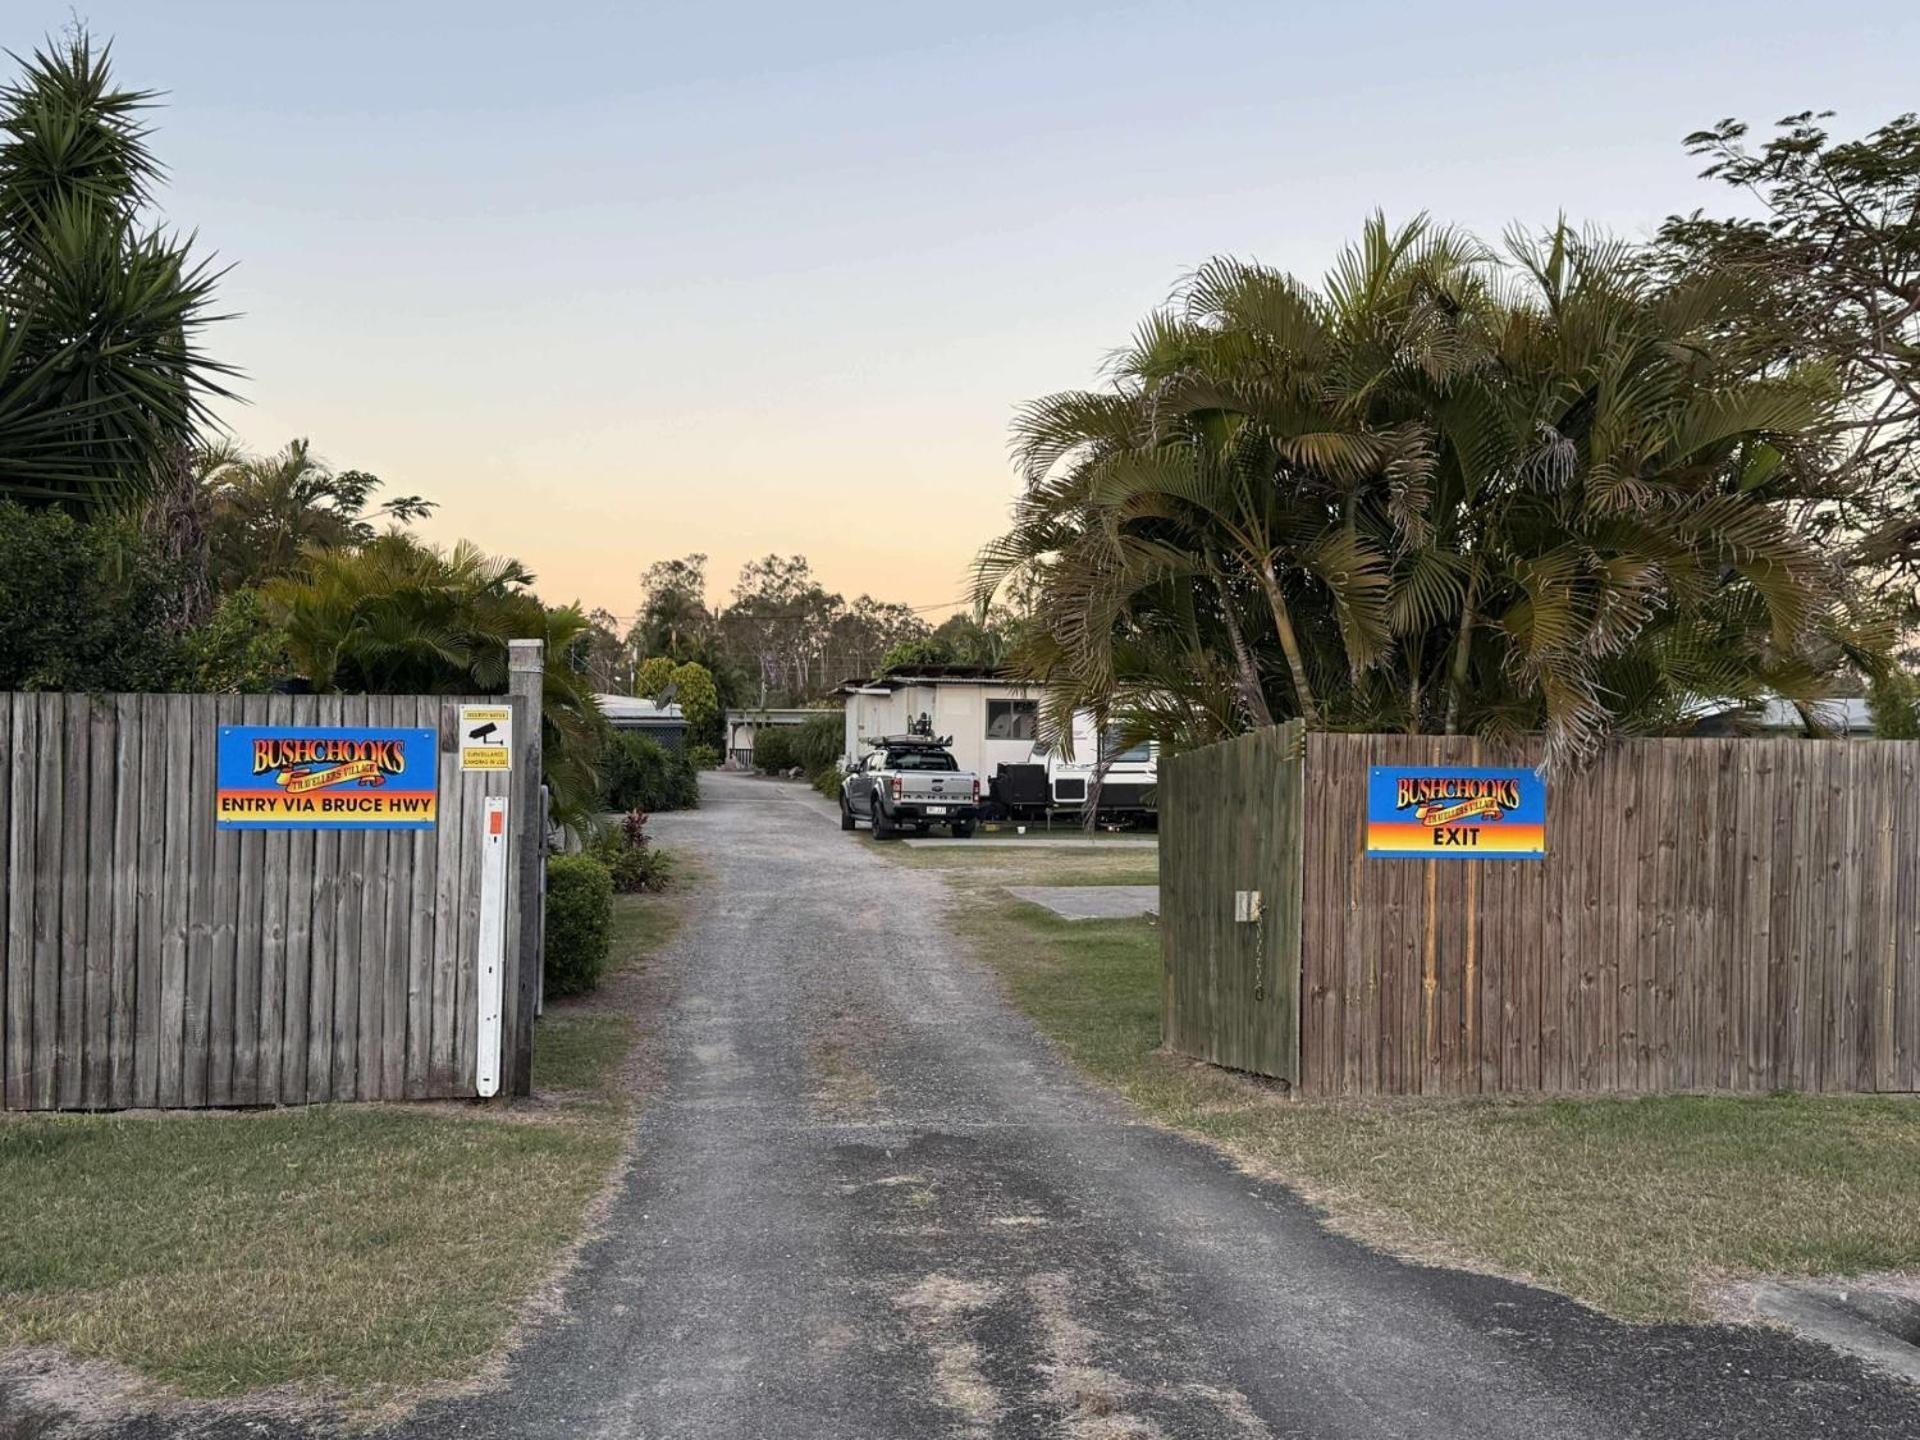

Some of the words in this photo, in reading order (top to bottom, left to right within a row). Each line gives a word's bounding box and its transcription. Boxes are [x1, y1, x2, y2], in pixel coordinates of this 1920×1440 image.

[252, 739, 406, 775] BUSHCHOOKS
[291, 770, 342, 791] TRAVELLERS
[343, 763, 376, 778] VILLAGE
[222, 798, 277, 812] ENTRY
[284, 798, 315, 812] VIA
[322, 798, 382, 812] BRUCE
[389, 798, 431, 812] HWY
[1396, 778, 1520, 809] BUSHCHOOKS
[1427, 806, 1468, 824] TRAVELLERS
[1433, 828, 1480, 845] EXIT
